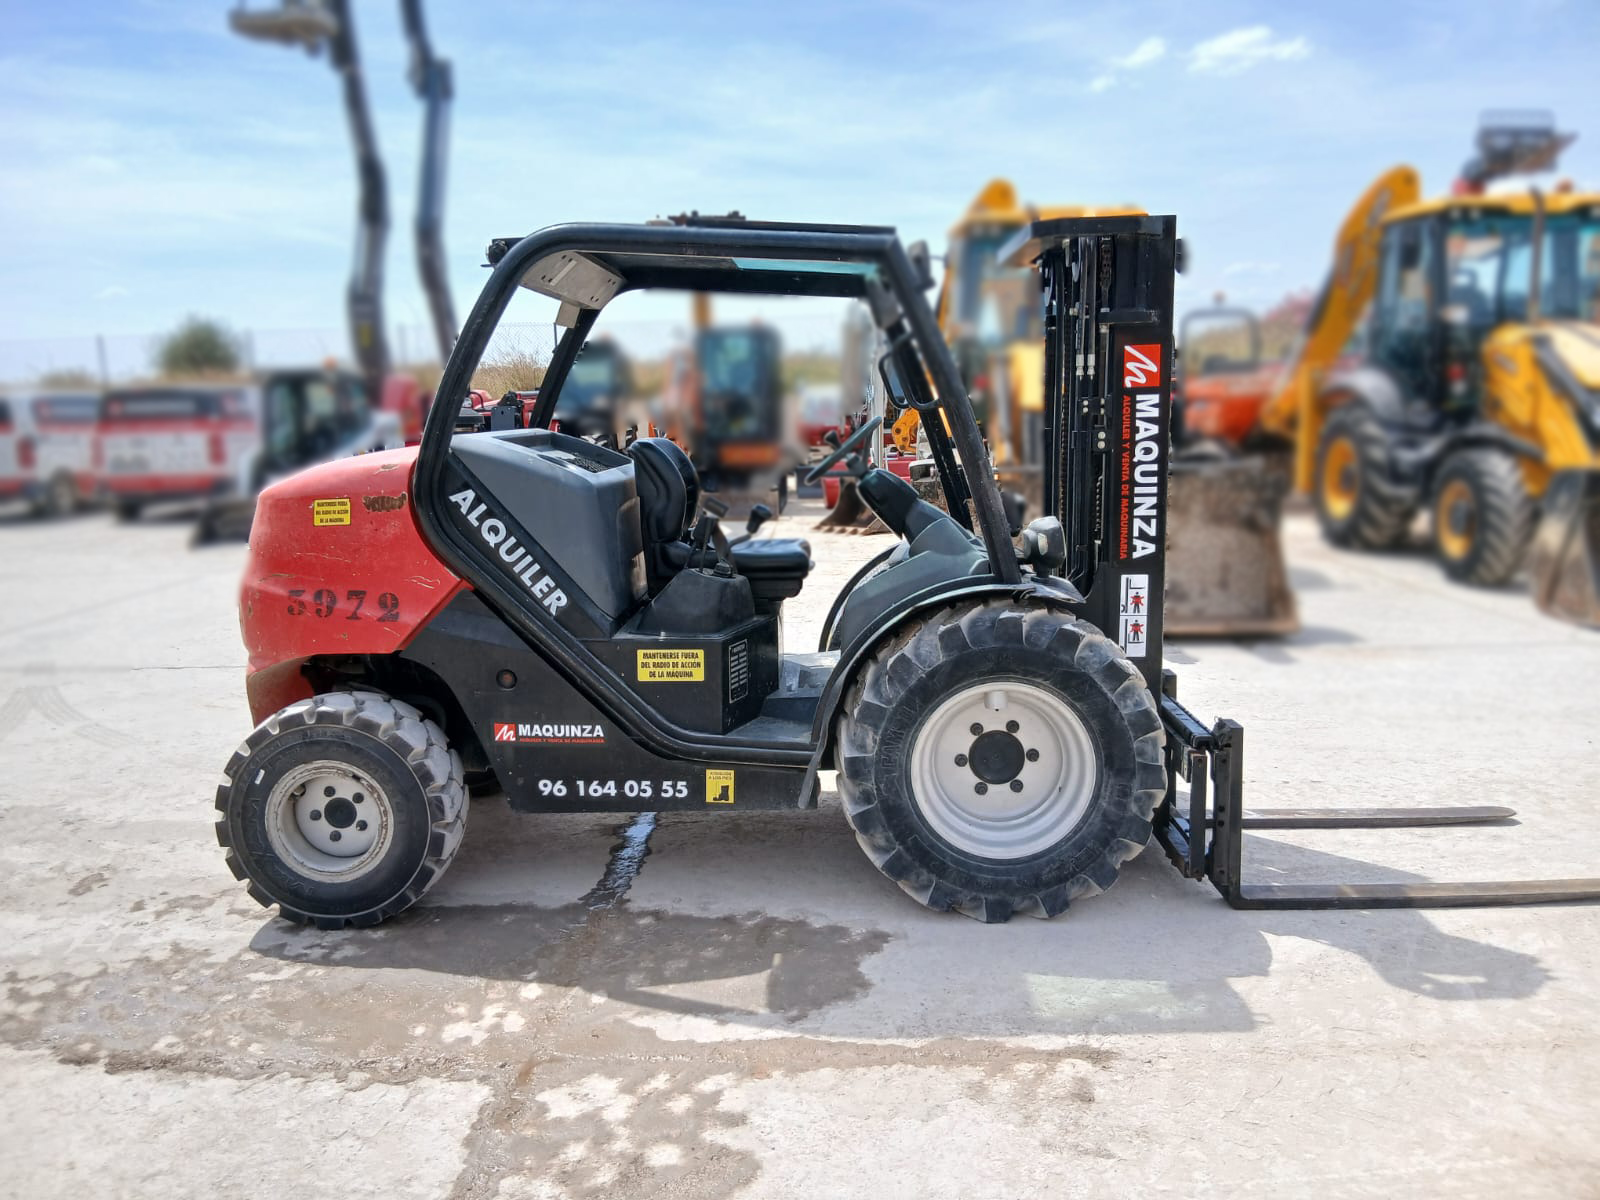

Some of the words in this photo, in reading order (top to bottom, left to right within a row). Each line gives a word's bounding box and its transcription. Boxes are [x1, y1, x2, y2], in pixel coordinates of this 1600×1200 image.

[1122, 395, 1131, 440] ALQUILER
[1121, 451, 1130, 481] VENTA
[1132, 393, 1160, 560] MAQUINZA
[1121, 484, 1130, 496] DE
[1119, 498, 1129, 559] MAQUINARIA
[448, 489, 568, 616] ALQUILER
[287, 589, 400, 622] 5972
[640, 661, 651, 669] DEL
[652, 661, 671, 669] RADIO
[671, 661, 680, 669] DE
[642, 652, 680, 660] MANTENERSE
[681, 652, 699, 660] FUERA
[649, 670, 657, 678] DE
[657, 670, 665, 678] LA
[518, 724, 605, 738] MAQUINZA
[538, 779, 567, 797] 96
[576, 780, 617, 797] 164
[624, 780, 652, 798] 05
[660, 780, 688, 798] 55
